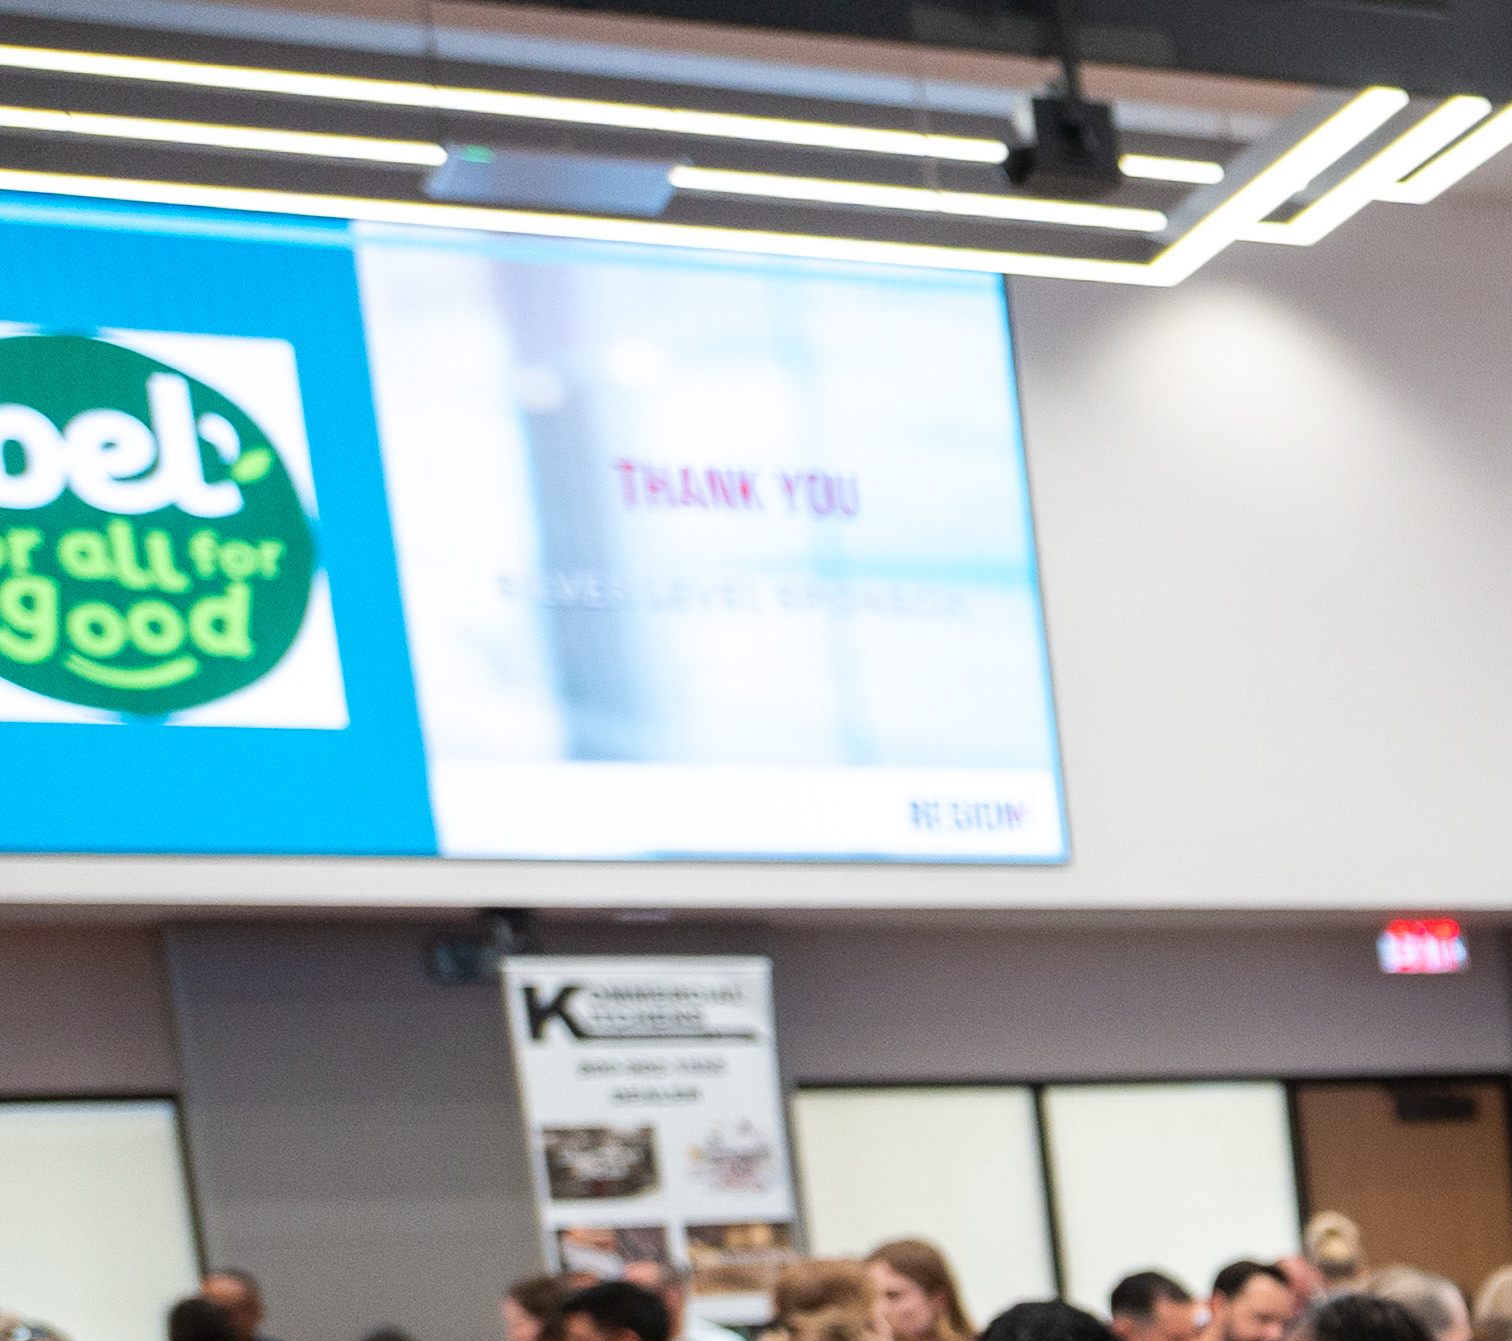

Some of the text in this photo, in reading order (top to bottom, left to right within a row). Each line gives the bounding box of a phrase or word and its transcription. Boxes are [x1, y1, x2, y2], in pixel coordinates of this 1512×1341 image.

[613, 457, 860, 522] THANK YOU
[56, 517, 192, 594] all
[187, 526, 287, 581] for
[0, 575, 257, 664] good
